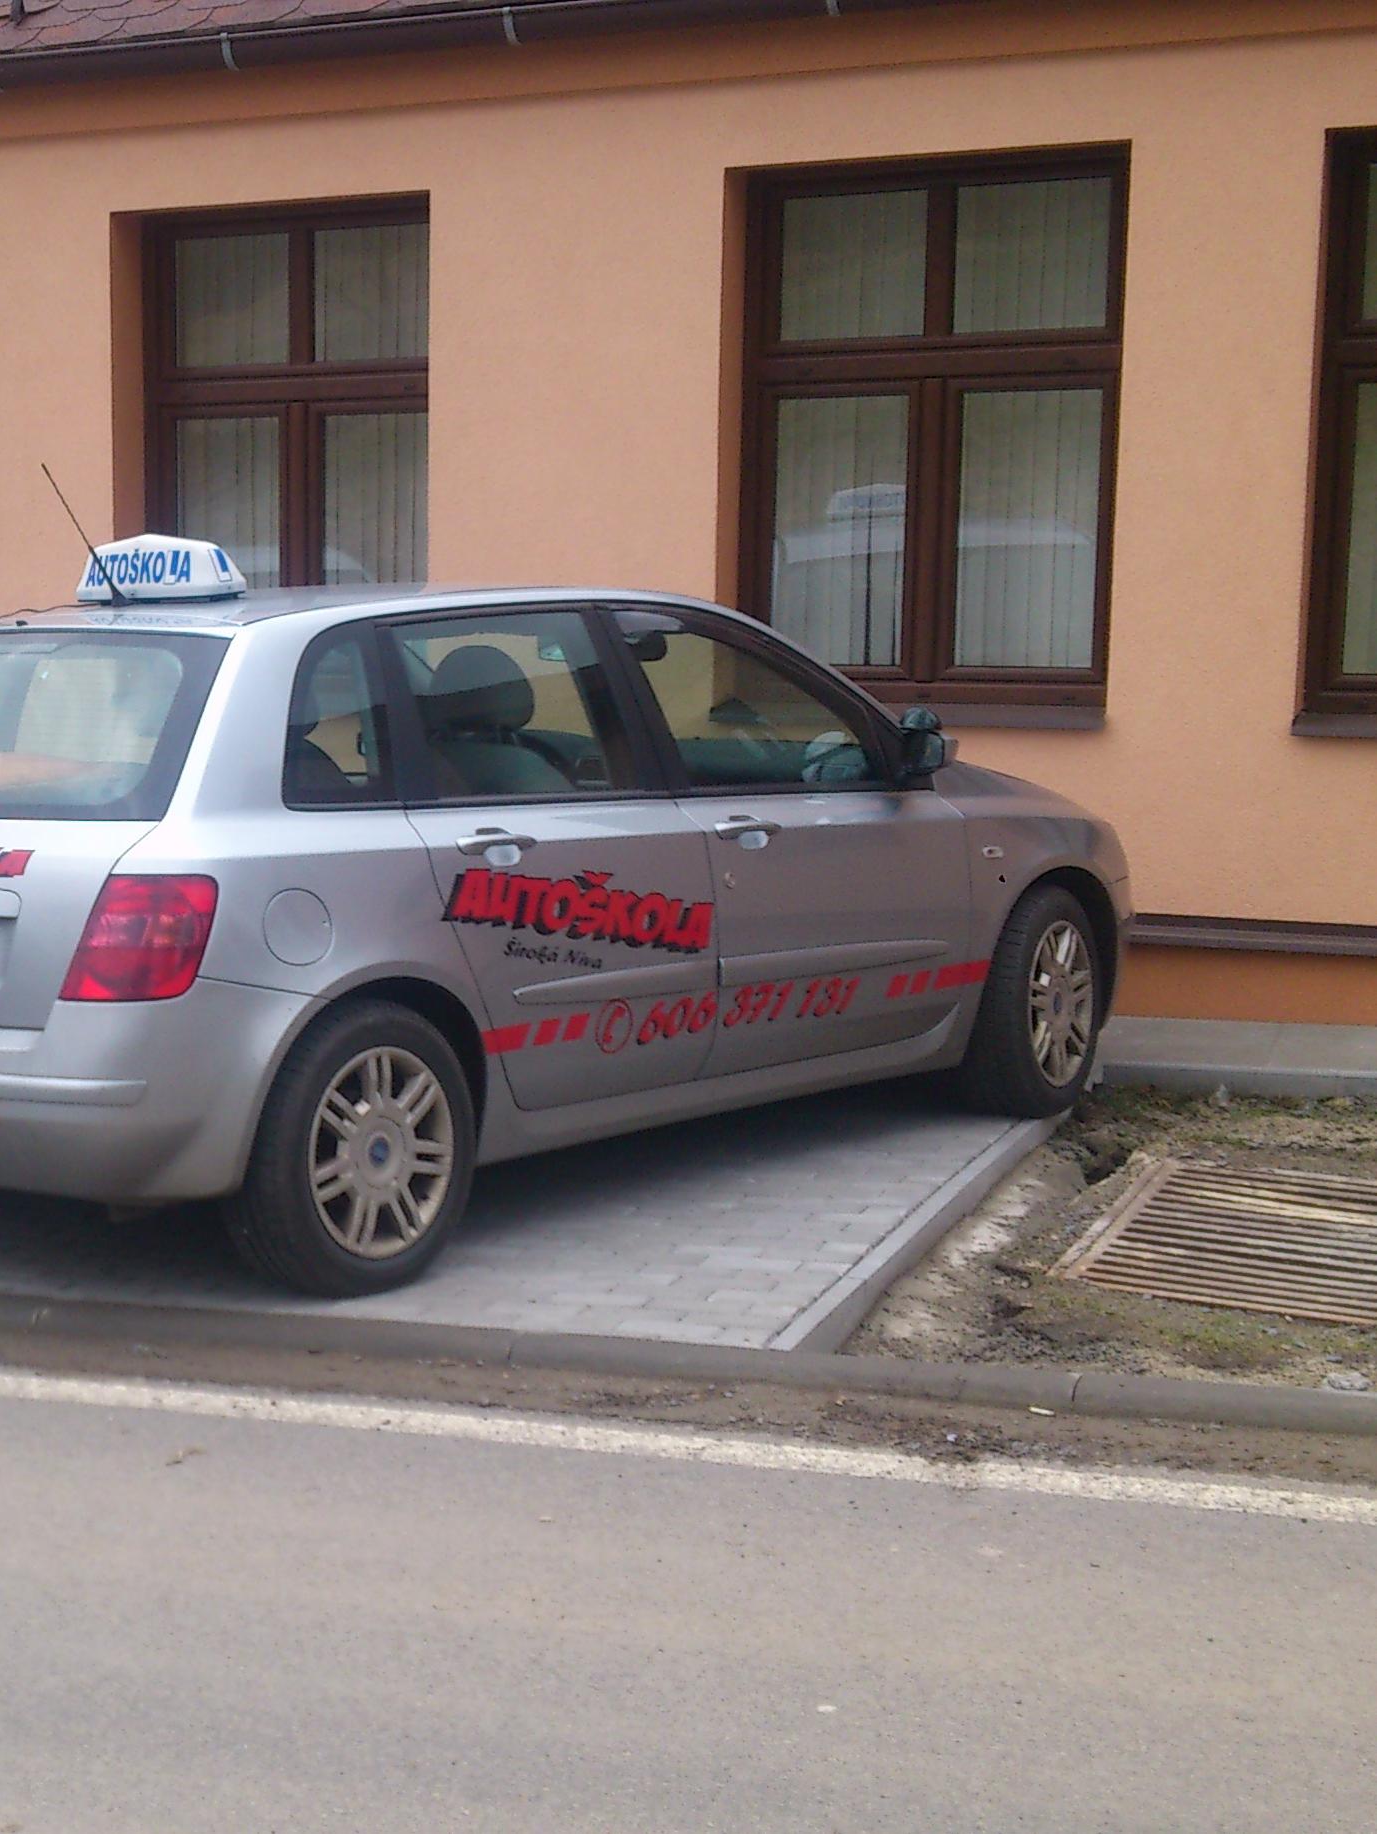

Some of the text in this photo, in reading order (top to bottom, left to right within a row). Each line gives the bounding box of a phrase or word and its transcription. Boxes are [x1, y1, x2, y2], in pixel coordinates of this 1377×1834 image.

[442, 868, 715, 954] AUTOŠKOLA
[637, 975, 861, 1046] 606 371 131
